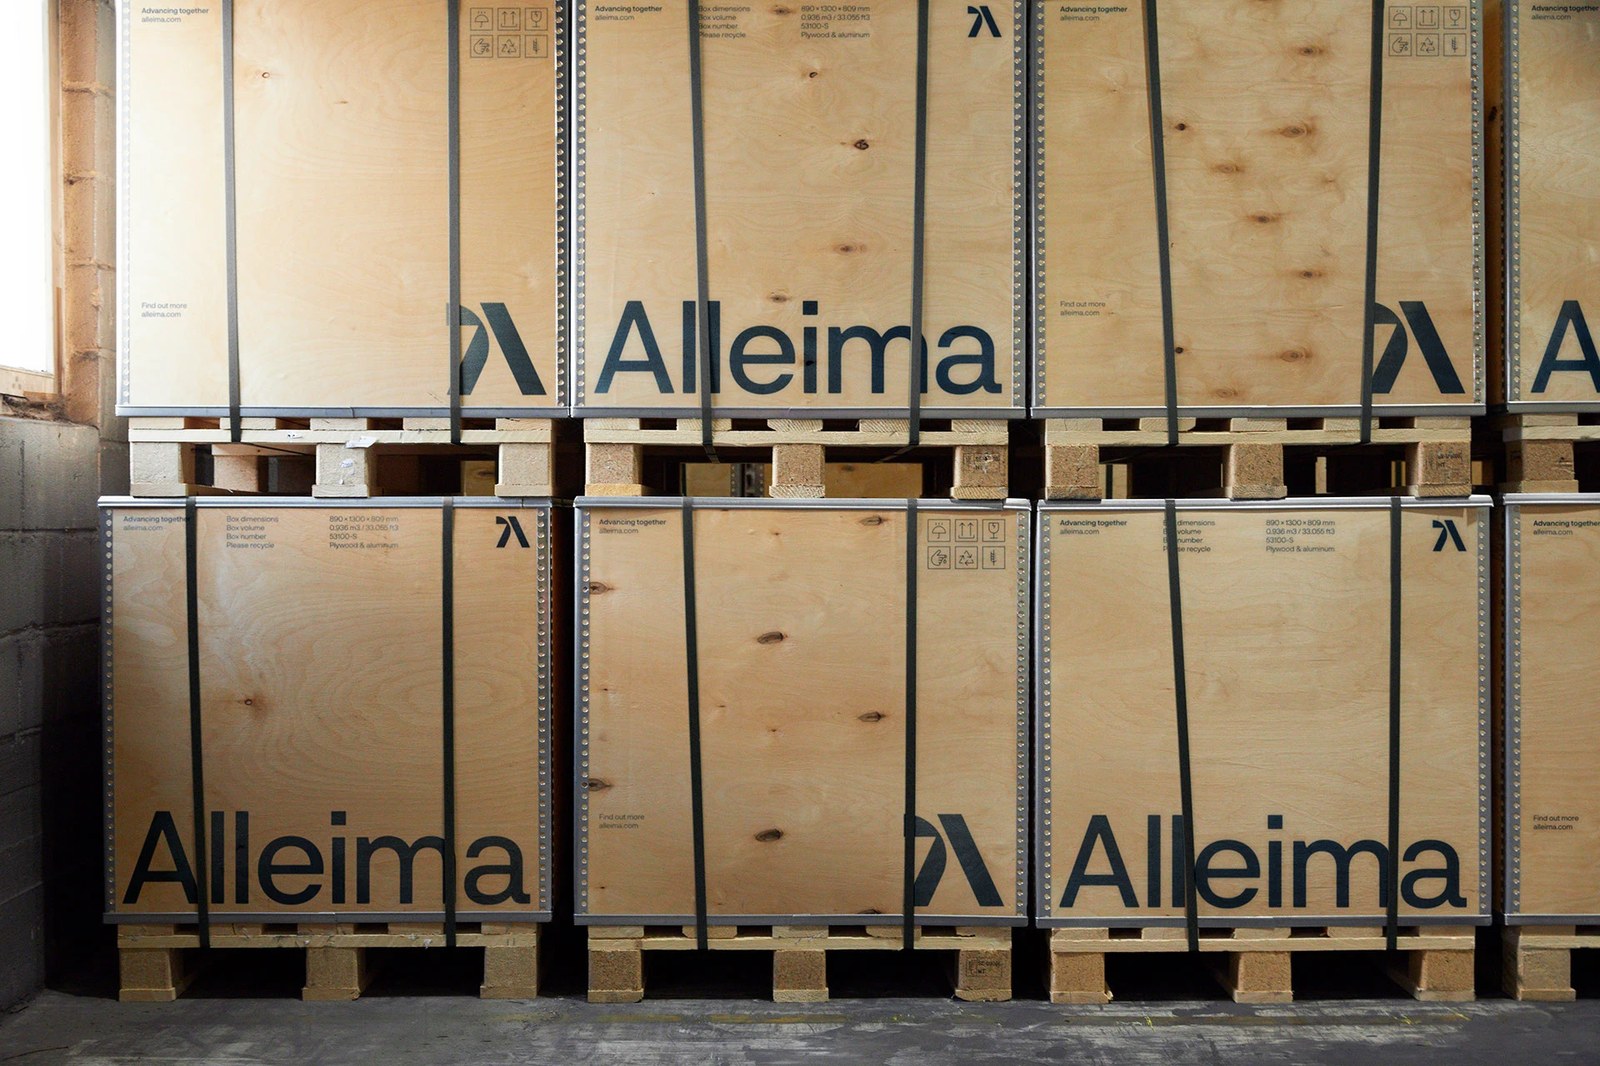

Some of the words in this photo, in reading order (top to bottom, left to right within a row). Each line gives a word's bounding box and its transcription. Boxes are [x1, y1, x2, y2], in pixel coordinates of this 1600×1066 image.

[594, 301, 1002, 394] Alleima
[123, 811, 530, 904] Alleima
[1059, 815, 1467, 908] Alleima
